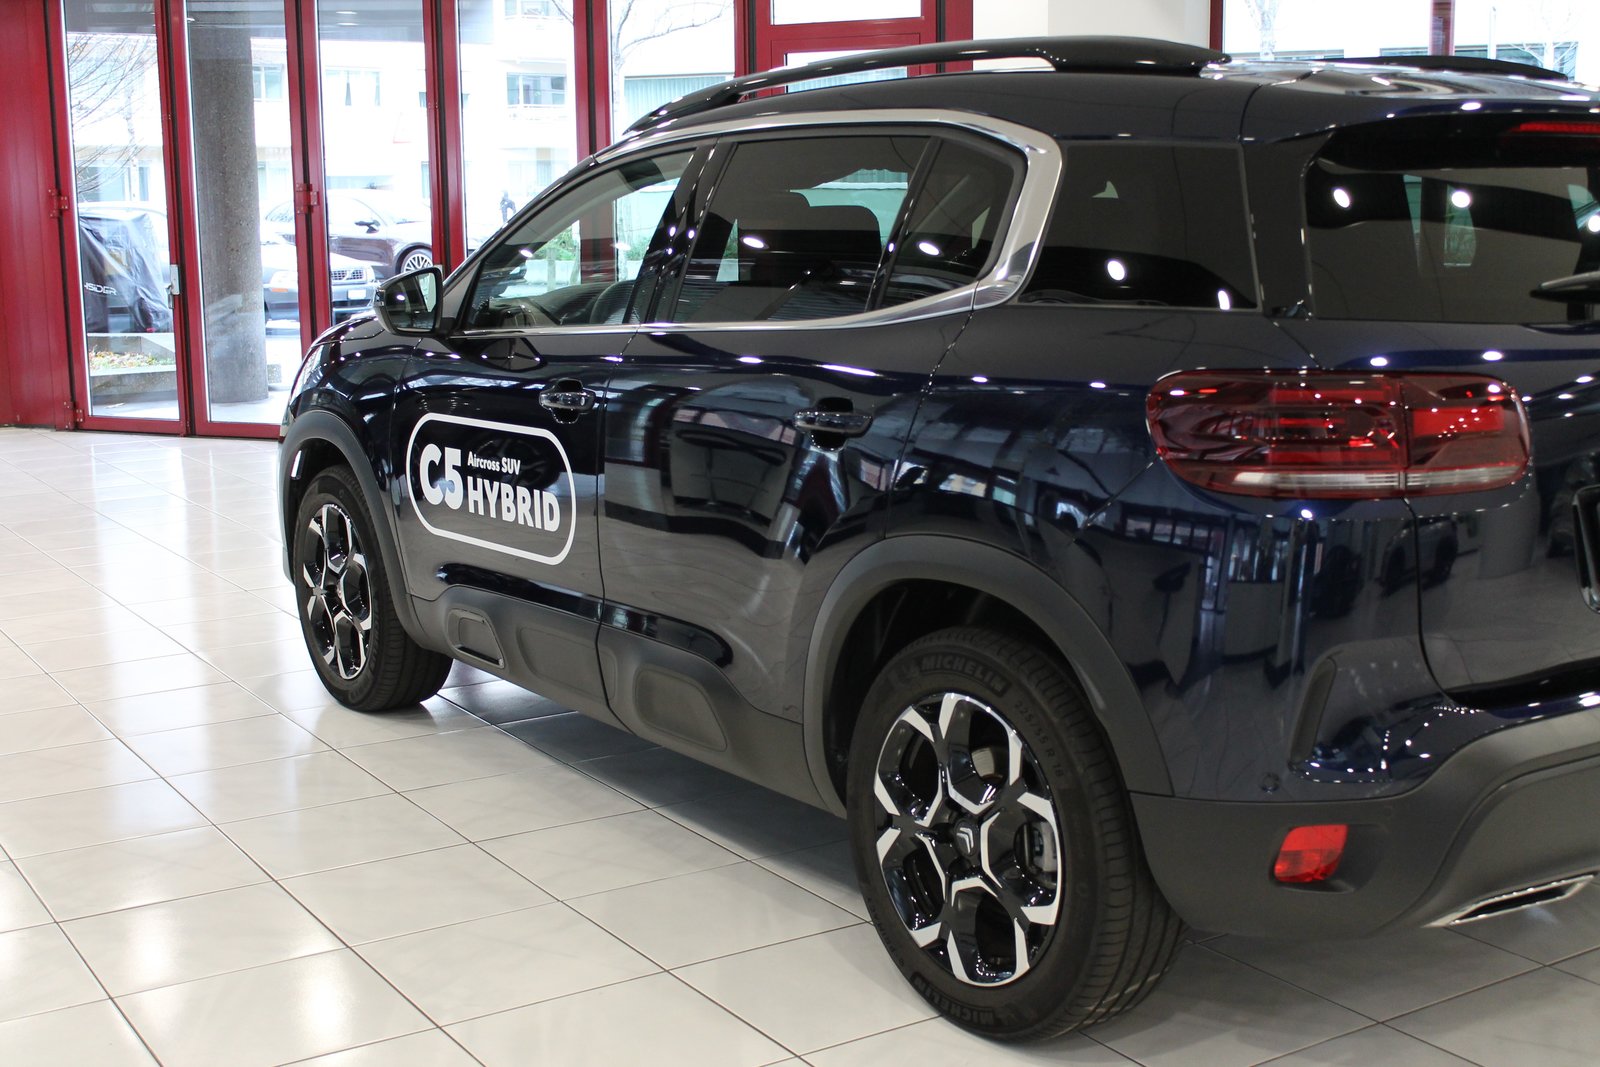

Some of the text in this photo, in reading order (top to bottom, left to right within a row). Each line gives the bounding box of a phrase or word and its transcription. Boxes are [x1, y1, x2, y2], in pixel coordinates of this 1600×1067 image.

[419, 443, 464, 510] C5
[467, 451, 520, 475] Aircross SUV
[467, 476, 560, 532] HYBRID
[921, 656, 1005, 691] MICHELIN
[912, 975, 994, 1025] MICHELIN
